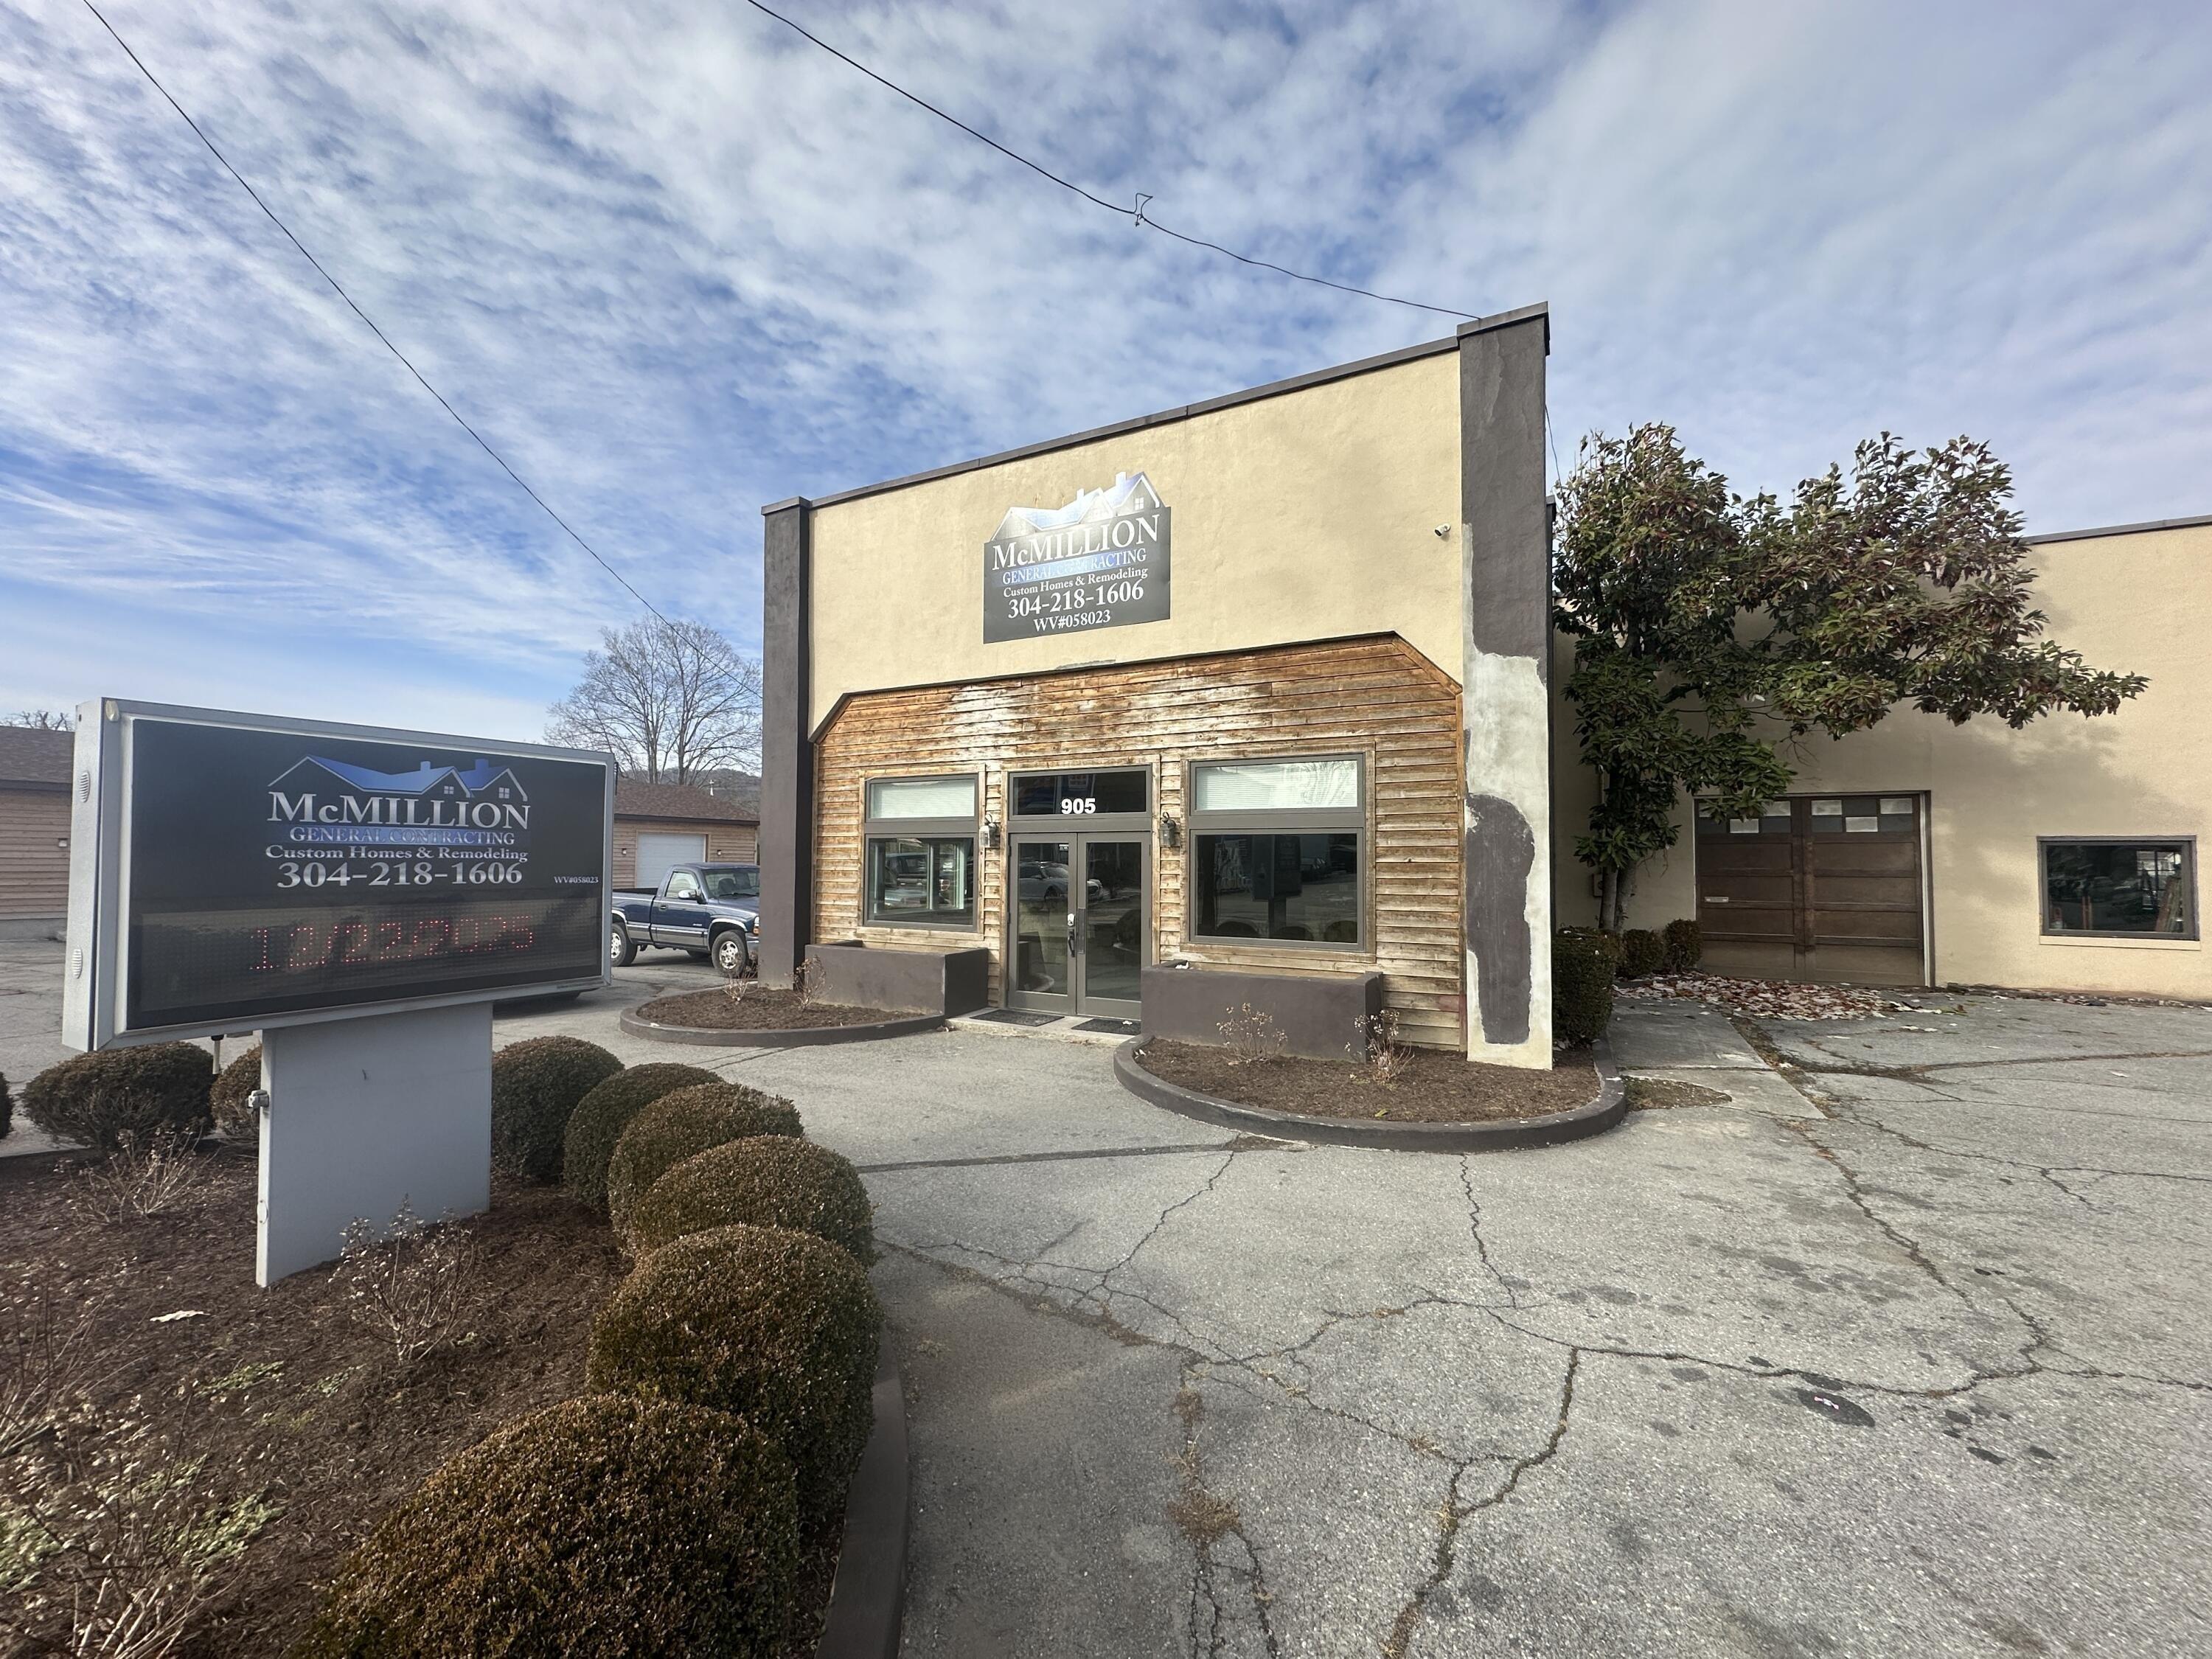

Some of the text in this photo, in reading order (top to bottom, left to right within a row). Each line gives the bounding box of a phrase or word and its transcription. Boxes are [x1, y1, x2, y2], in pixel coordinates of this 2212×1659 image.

[992, 514, 1160, 571] McMILLION
[1003, 566, 1052, 585] GENERAL
[1003, 567, 1148, 598] Custom Homes & Remodeling
[1008, 578, 1144, 619] 304-218-1606
[1034, 609, 1111, 632] WV#058023
[267, 791, 531, 830] McMILLION
[1061, 798, 1096, 815] 905
[290, 827, 515, 846] GENERAL CONTRACTING
[265, 844, 529, 863] Custom Homes & Remodeling
[276, 862, 523, 888] 304-218-1606
[554, 876, 599, 884] WV#058023
